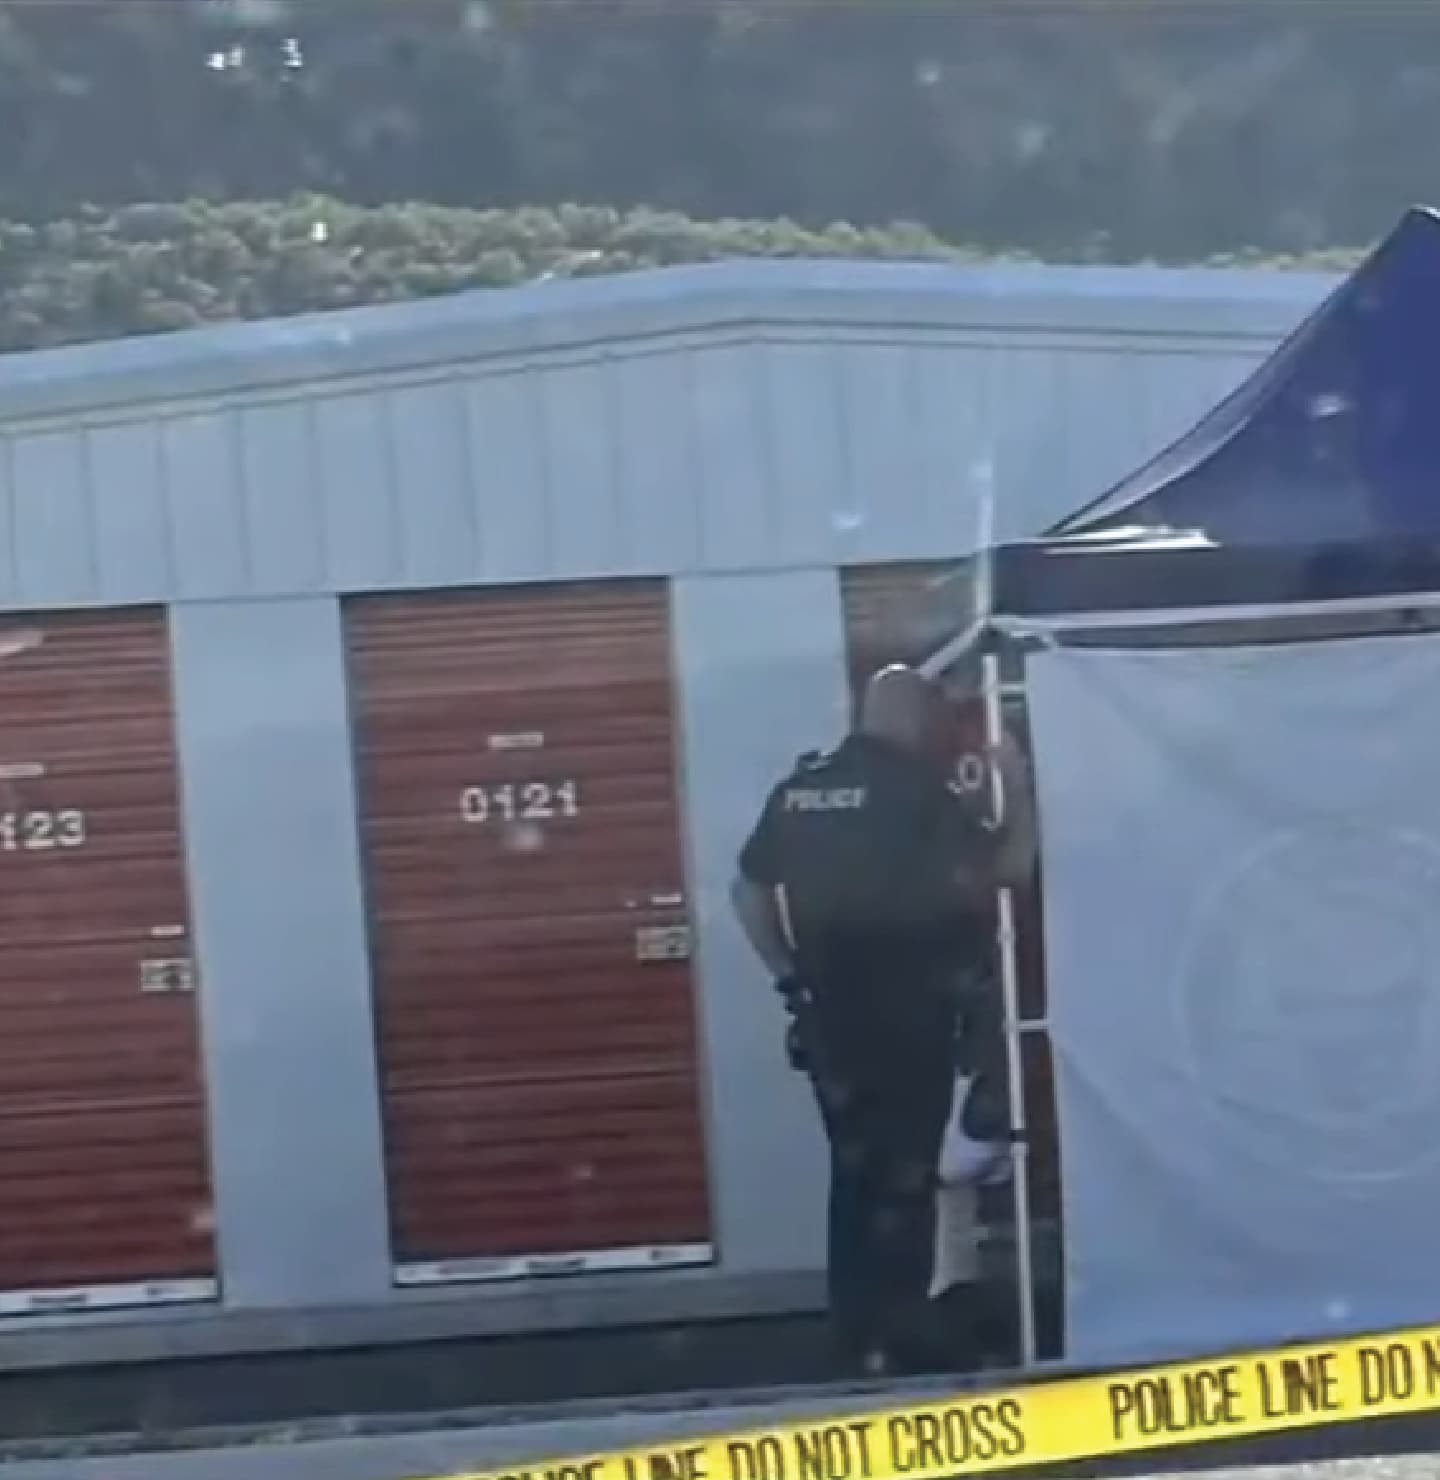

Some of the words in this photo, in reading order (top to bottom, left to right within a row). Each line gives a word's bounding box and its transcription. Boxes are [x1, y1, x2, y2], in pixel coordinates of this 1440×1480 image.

[460, 779, 577, 821] 0121
[784, 788, 865, 811] POLICE
[1109, 1366, 1241, 1439] POLICE
[1257, 1353, 1339, 1418] LINE
[1360, 1344, 1412, 1405] DO
[727, 1437, 785, 1480] DO
[794, 1421, 875, 1480] NOT
[888, 1399, 1025, 1473] CROSS
